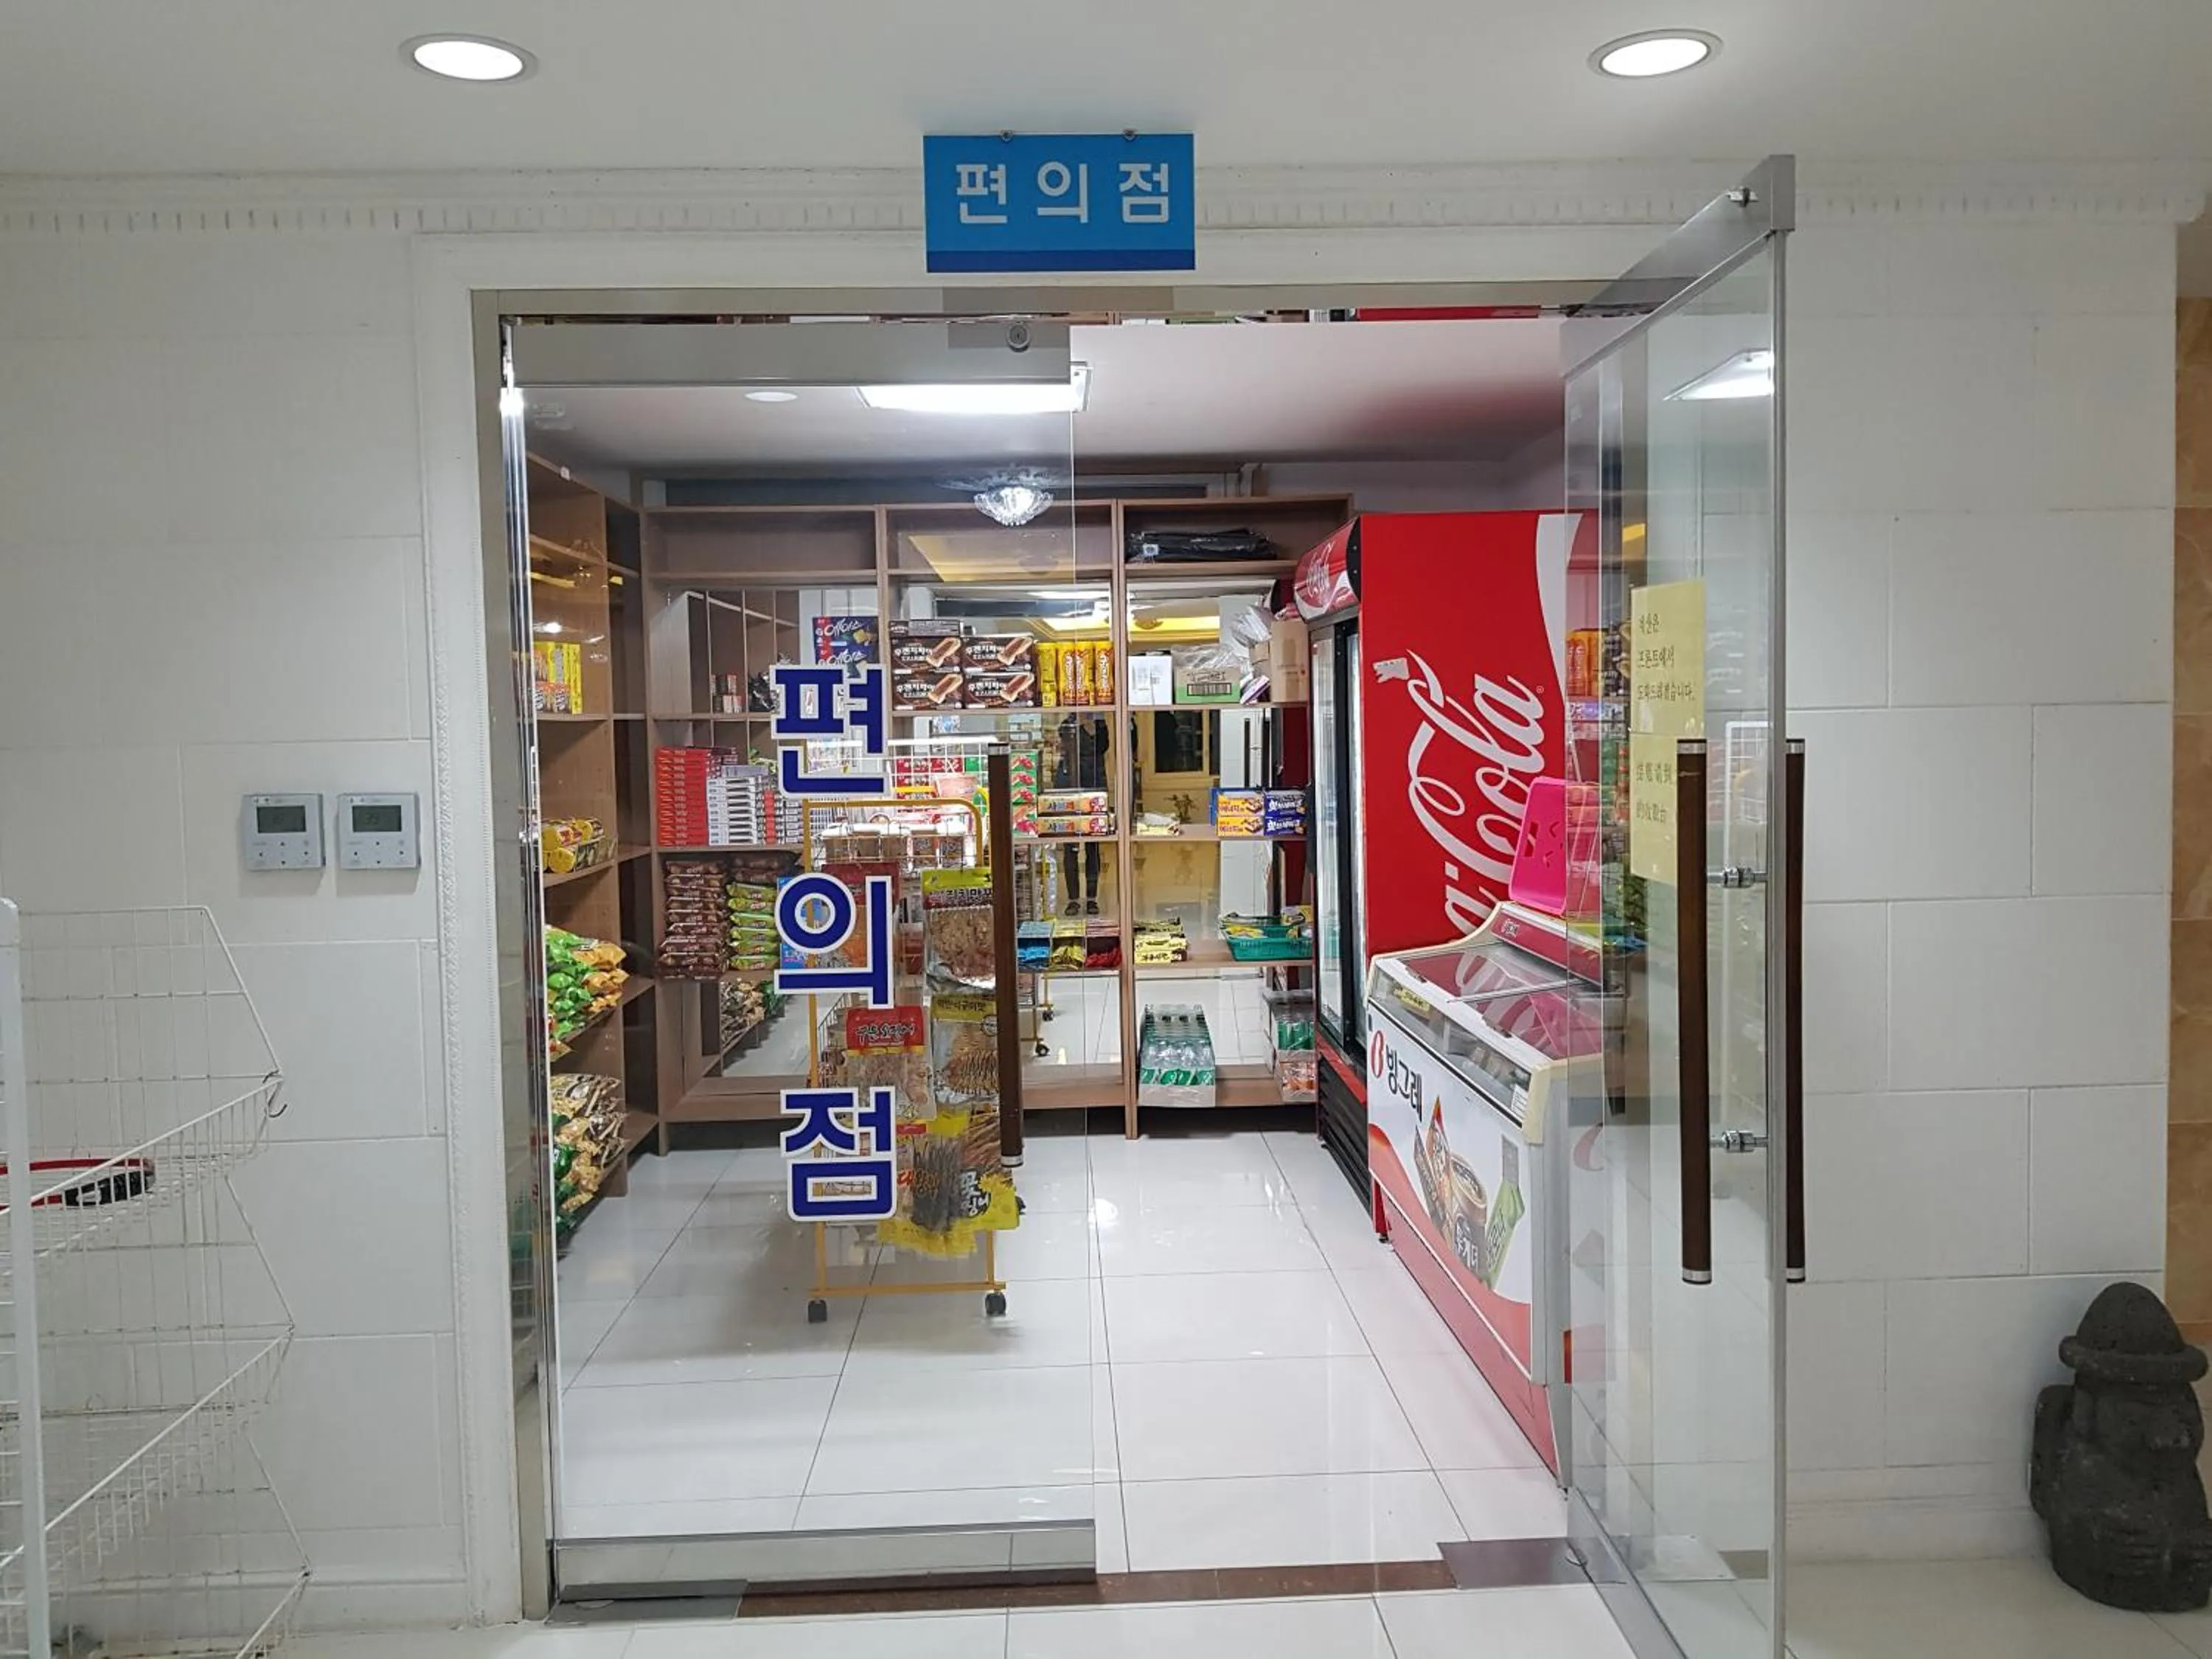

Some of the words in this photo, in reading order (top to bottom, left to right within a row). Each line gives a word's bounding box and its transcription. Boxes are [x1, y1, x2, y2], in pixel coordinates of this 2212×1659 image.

[956, 161, 1169, 224] 편의점
[770, 664, 897, 1222] 편의점
[1385, 1043, 1422, 1122] 빙그레
